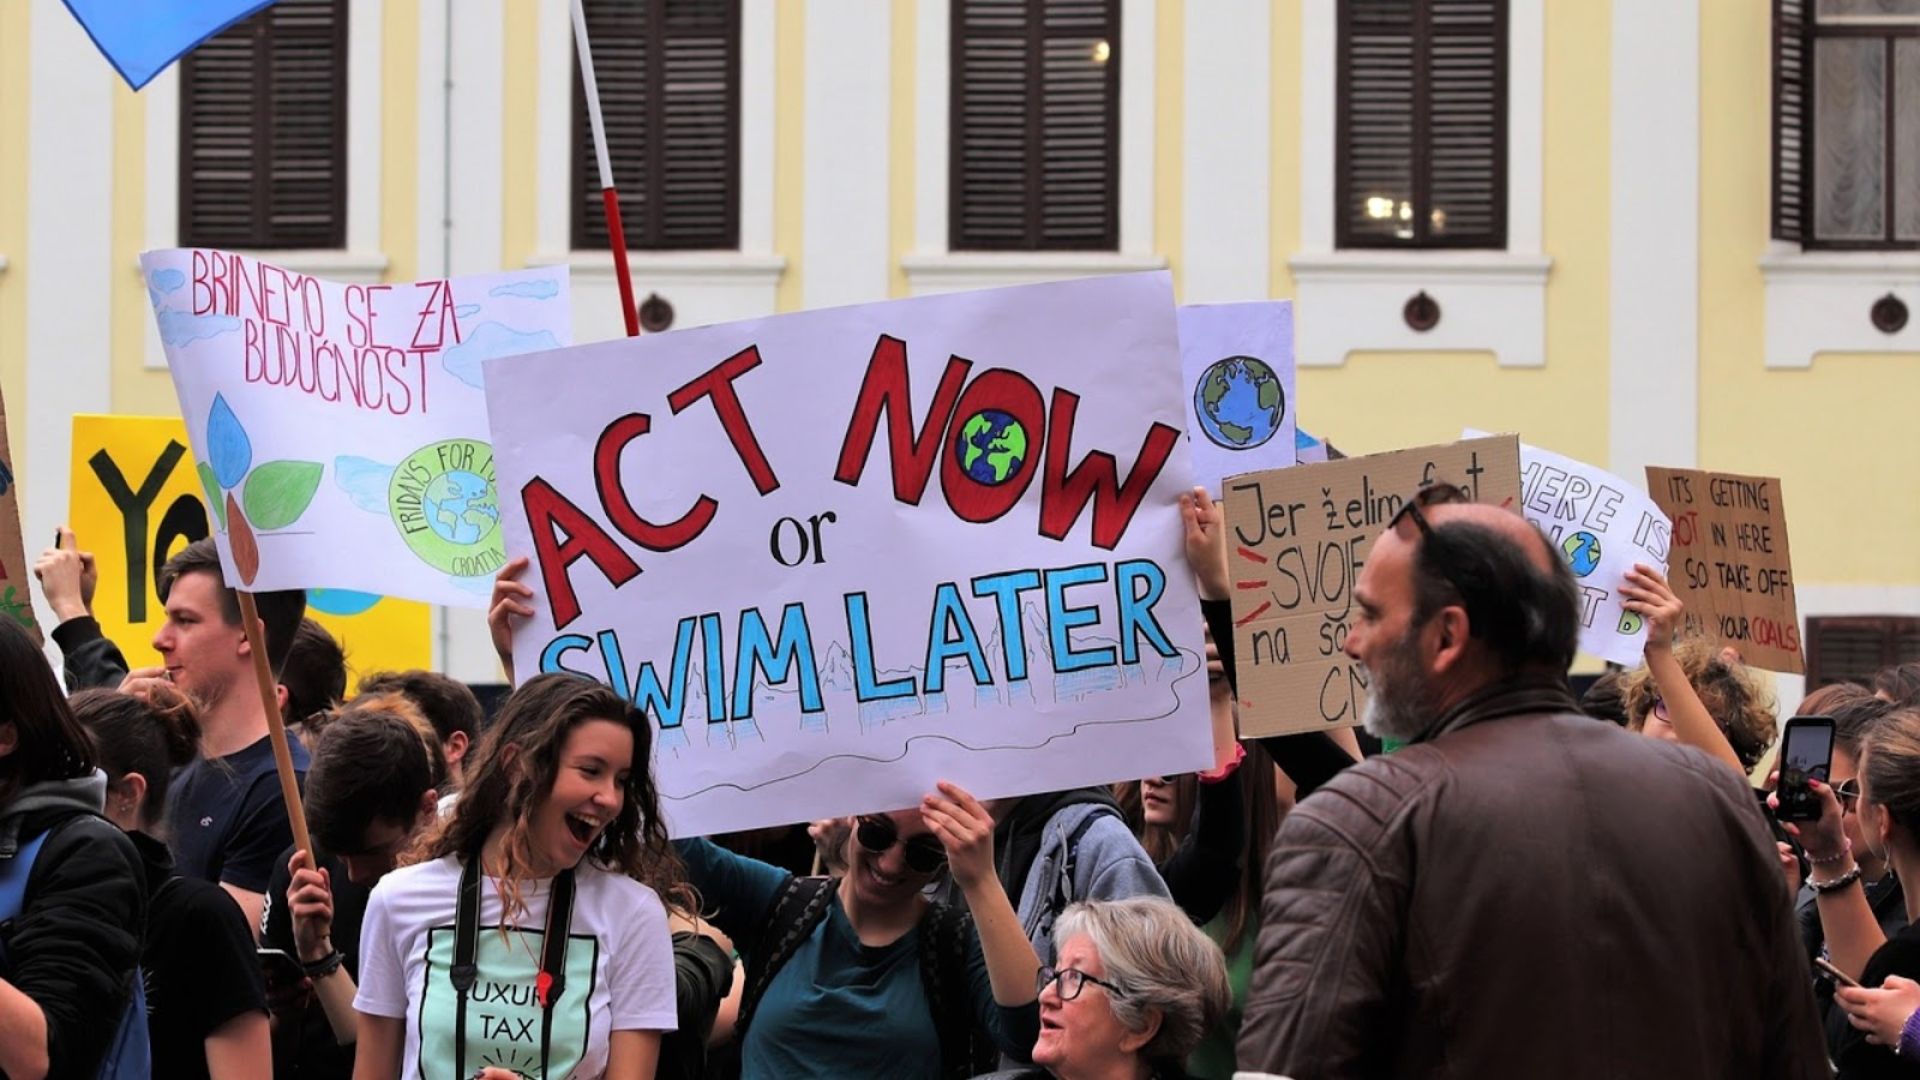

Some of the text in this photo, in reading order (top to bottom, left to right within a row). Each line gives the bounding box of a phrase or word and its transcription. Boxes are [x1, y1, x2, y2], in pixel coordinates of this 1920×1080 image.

[193, 250, 461, 350] BRINEMO SE ZA
[245, 317, 441, 415] BUDUĆNOST
[396, 459, 432, 535] FRIDAYS
[437, 443, 475, 472] FOR
[521, 333, 1182, 631] ACT NOW
[1709, 477, 1770, 513] GETTING
[770, 510, 837, 567] or
[1232, 482, 1306, 547] Jer
[1321, 475, 1404, 531] želim
[1632, 510, 1671, 565] IS
[1711, 521, 1727, 547] IN
[1736, 521, 1773, 554] HERE
[451, 546, 508, 577] CROATIA
[1684, 557, 1789, 601] SO TAKE OFF
[843, 559, 1179, 701] LATER
[1252, 626, 1291, 666] na
[1716, 613, 1752, 641] YOUR
[1751, 615, 1798, 653] COALS
[479, 1013, 535, 1044] TAX
